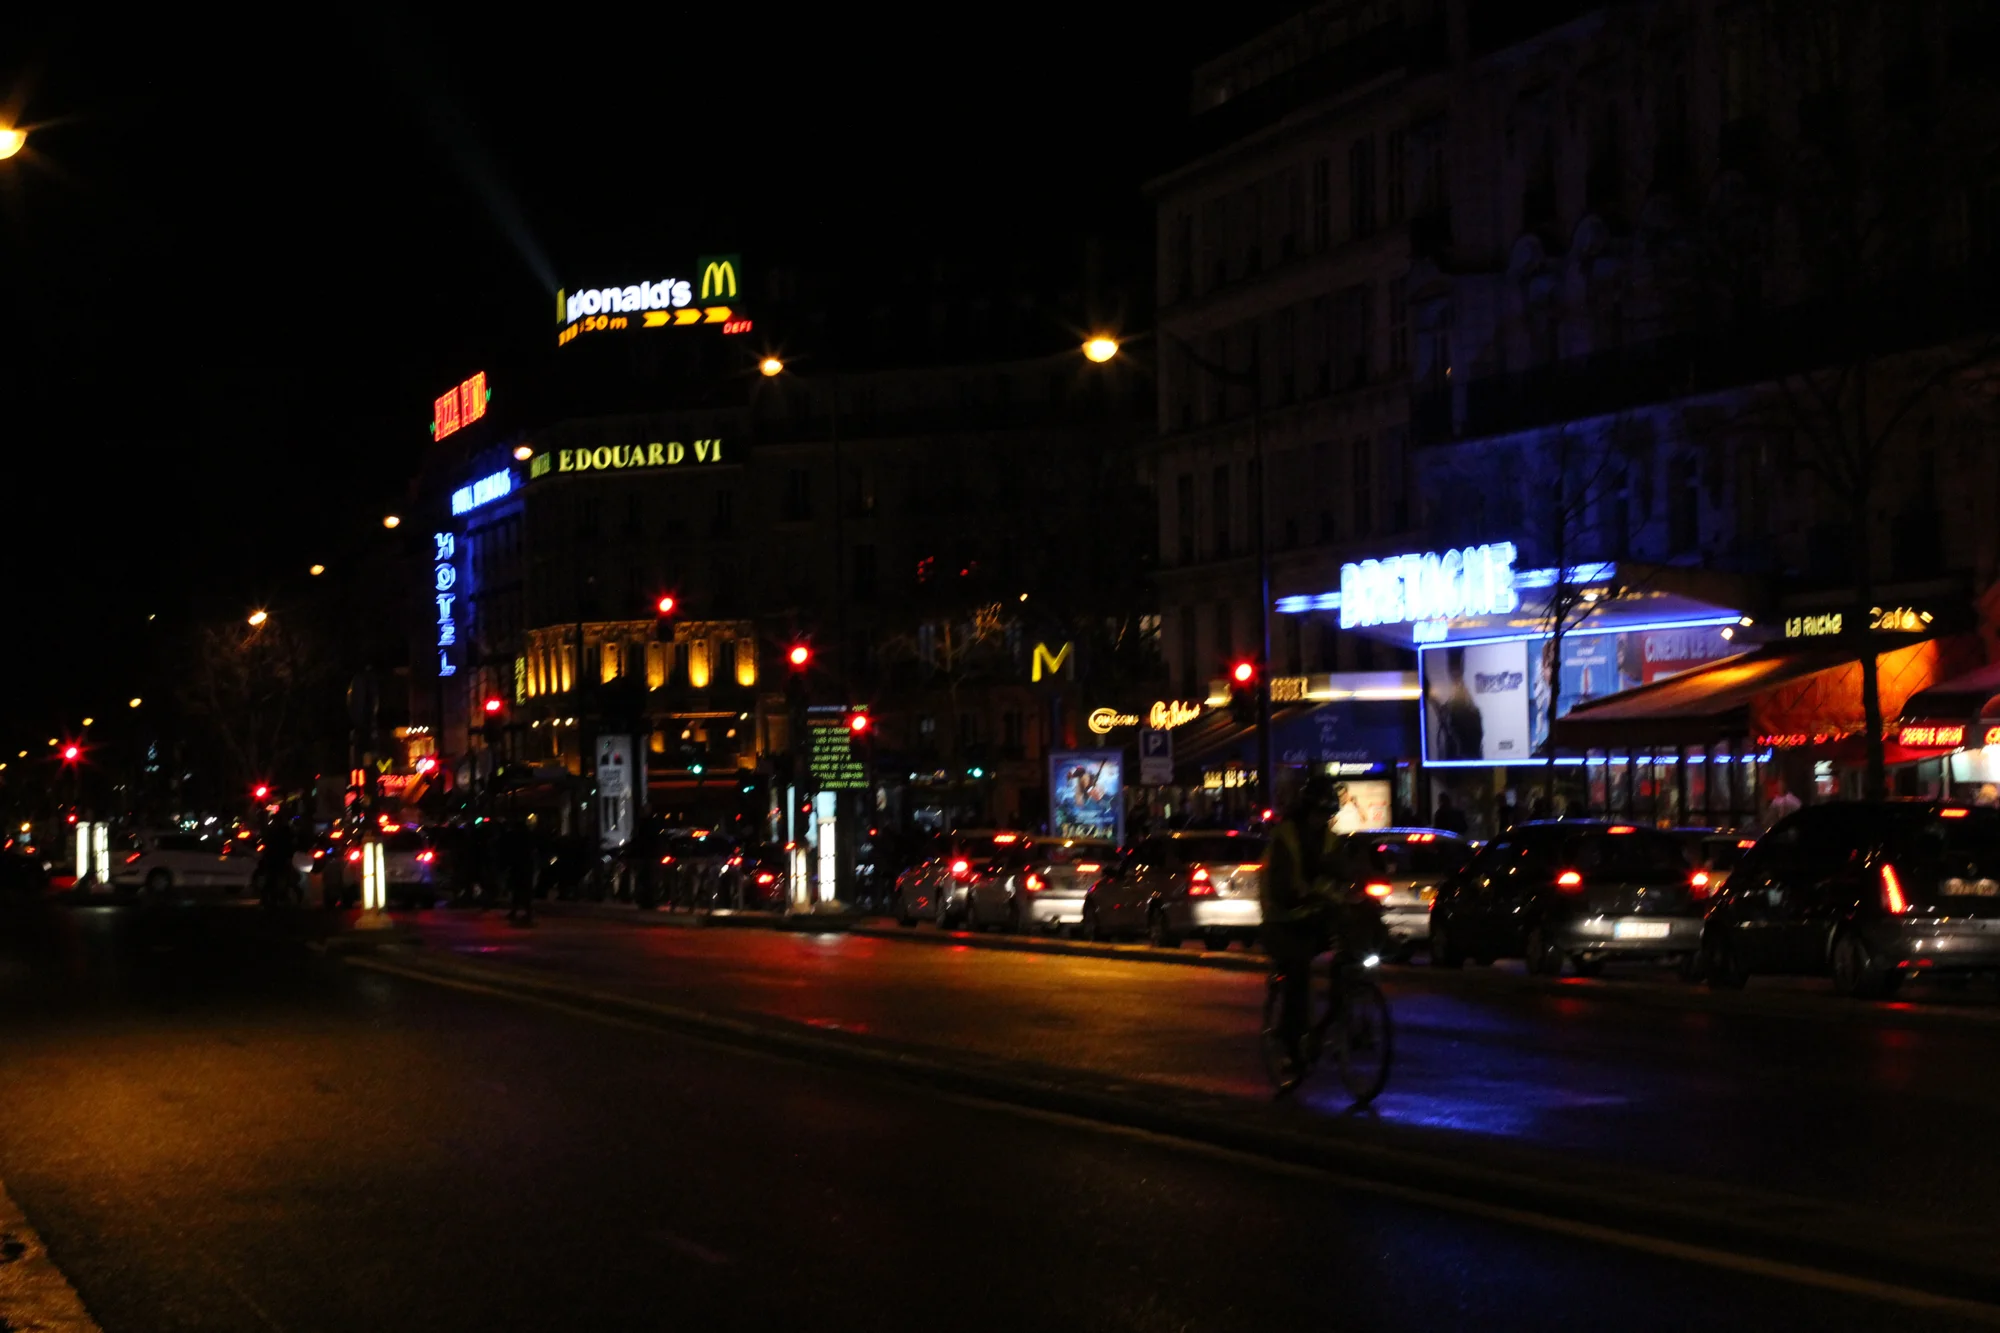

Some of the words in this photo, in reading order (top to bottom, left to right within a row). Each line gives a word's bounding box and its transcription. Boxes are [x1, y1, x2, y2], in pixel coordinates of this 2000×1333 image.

[558, 440, 684, 473] EDOUARD
[693, 438, 723, 463] VI
[434, 532, 457, 677] HOTEL
